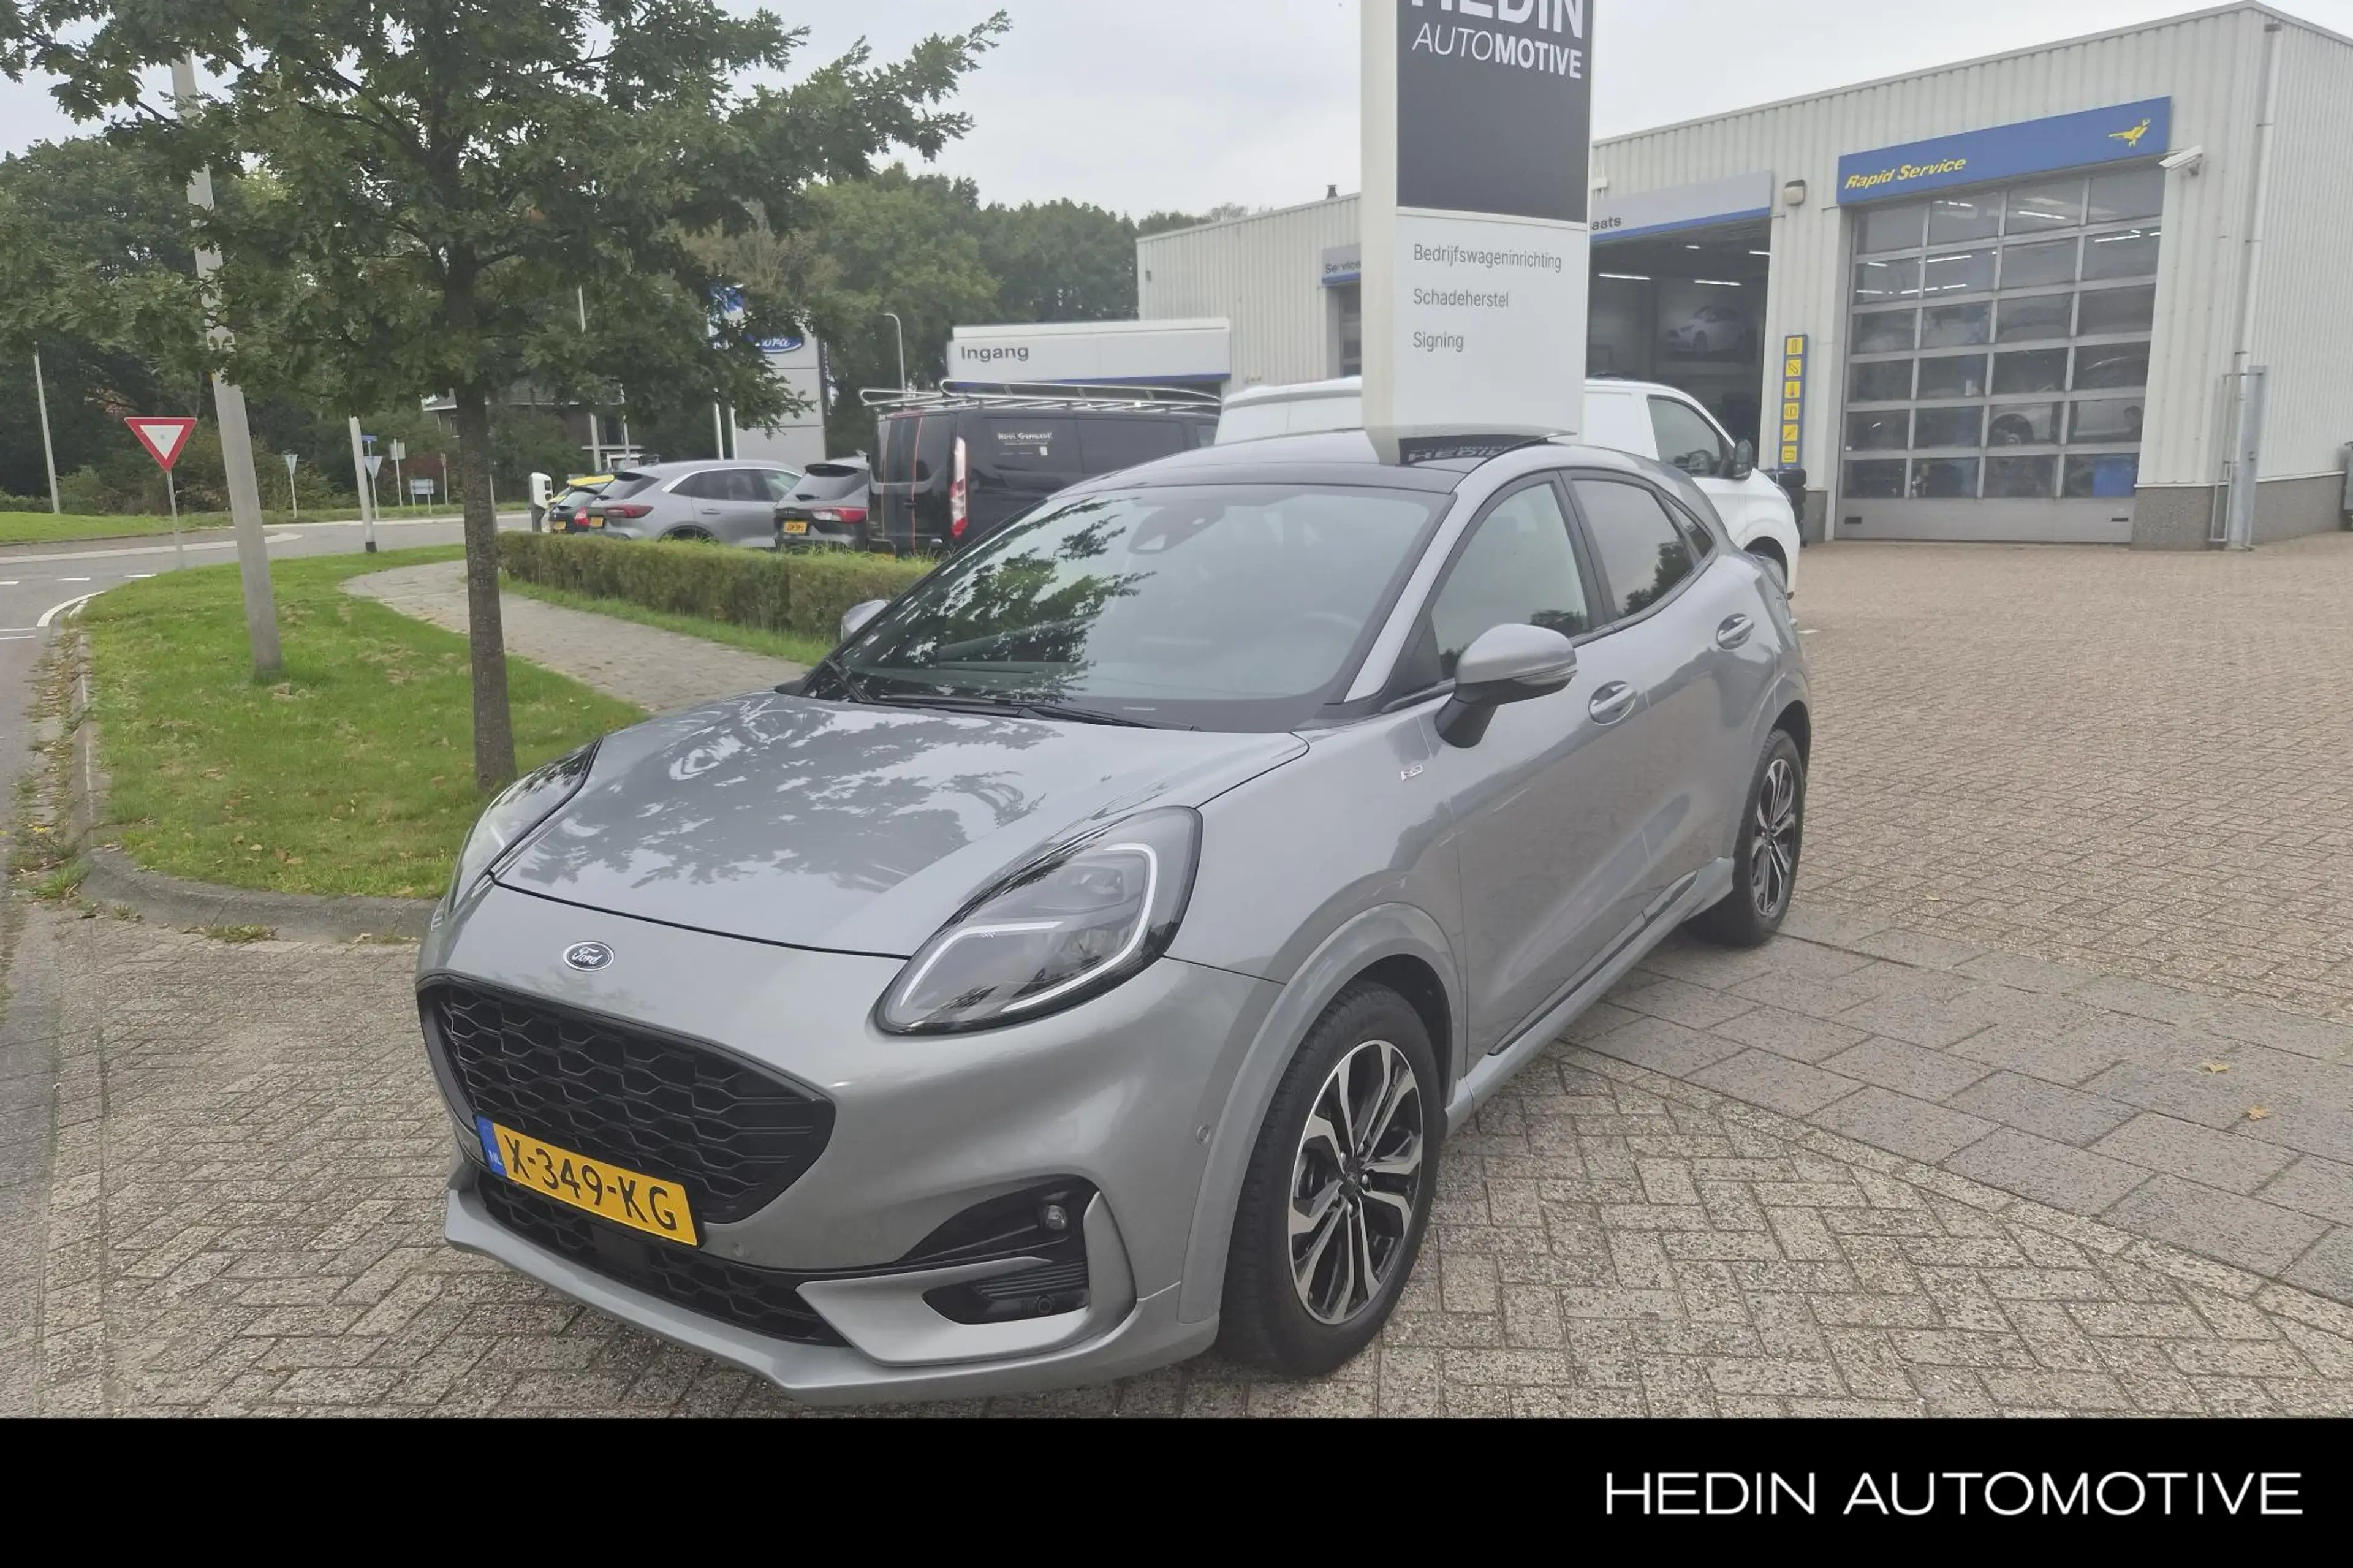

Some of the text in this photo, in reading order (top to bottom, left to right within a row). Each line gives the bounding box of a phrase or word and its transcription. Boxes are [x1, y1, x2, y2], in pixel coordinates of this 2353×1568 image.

[1411, 0, 1583, 39] DIN
[1411, 22, 1582, 79] AUTOMOTIVE
[1844, 157, 1967, 189] Rapid Service
[1590, 216, 1622, 230] aats
[1414, 243, 1562, 273] Bedrijfswageninrichting
[1413, 287, 1509, 308] Schadeherstel
[1413, 331, 1464, 353] Signing
[961, 346, 1029, 363] Ingang
[572, 945, 603, 965] Ford
[488, 1148, 503, 1165] NL
[504, 1134, 678, 1231] X-349-KG
